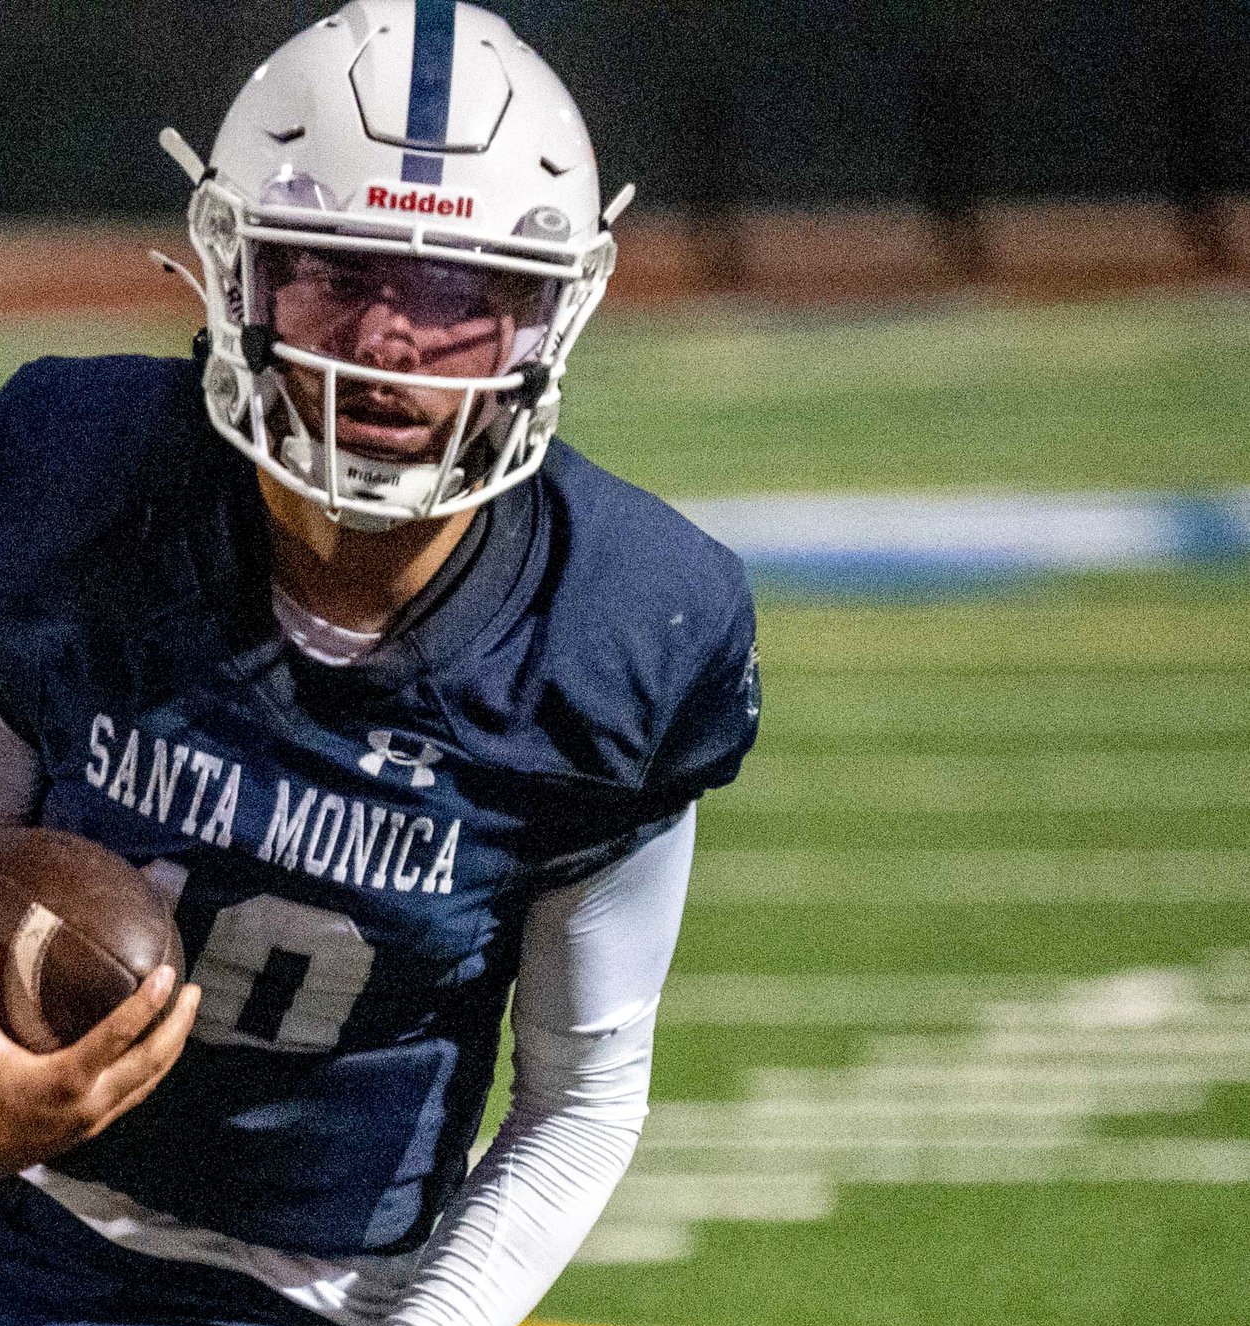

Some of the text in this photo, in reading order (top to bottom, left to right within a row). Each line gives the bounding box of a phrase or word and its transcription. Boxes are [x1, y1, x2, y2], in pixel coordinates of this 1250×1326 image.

[367, 186, 474, 218] Riddell
[347, 467, 401, 487] Riddell
[86, 713, 461, 894] SANTA MONICA
